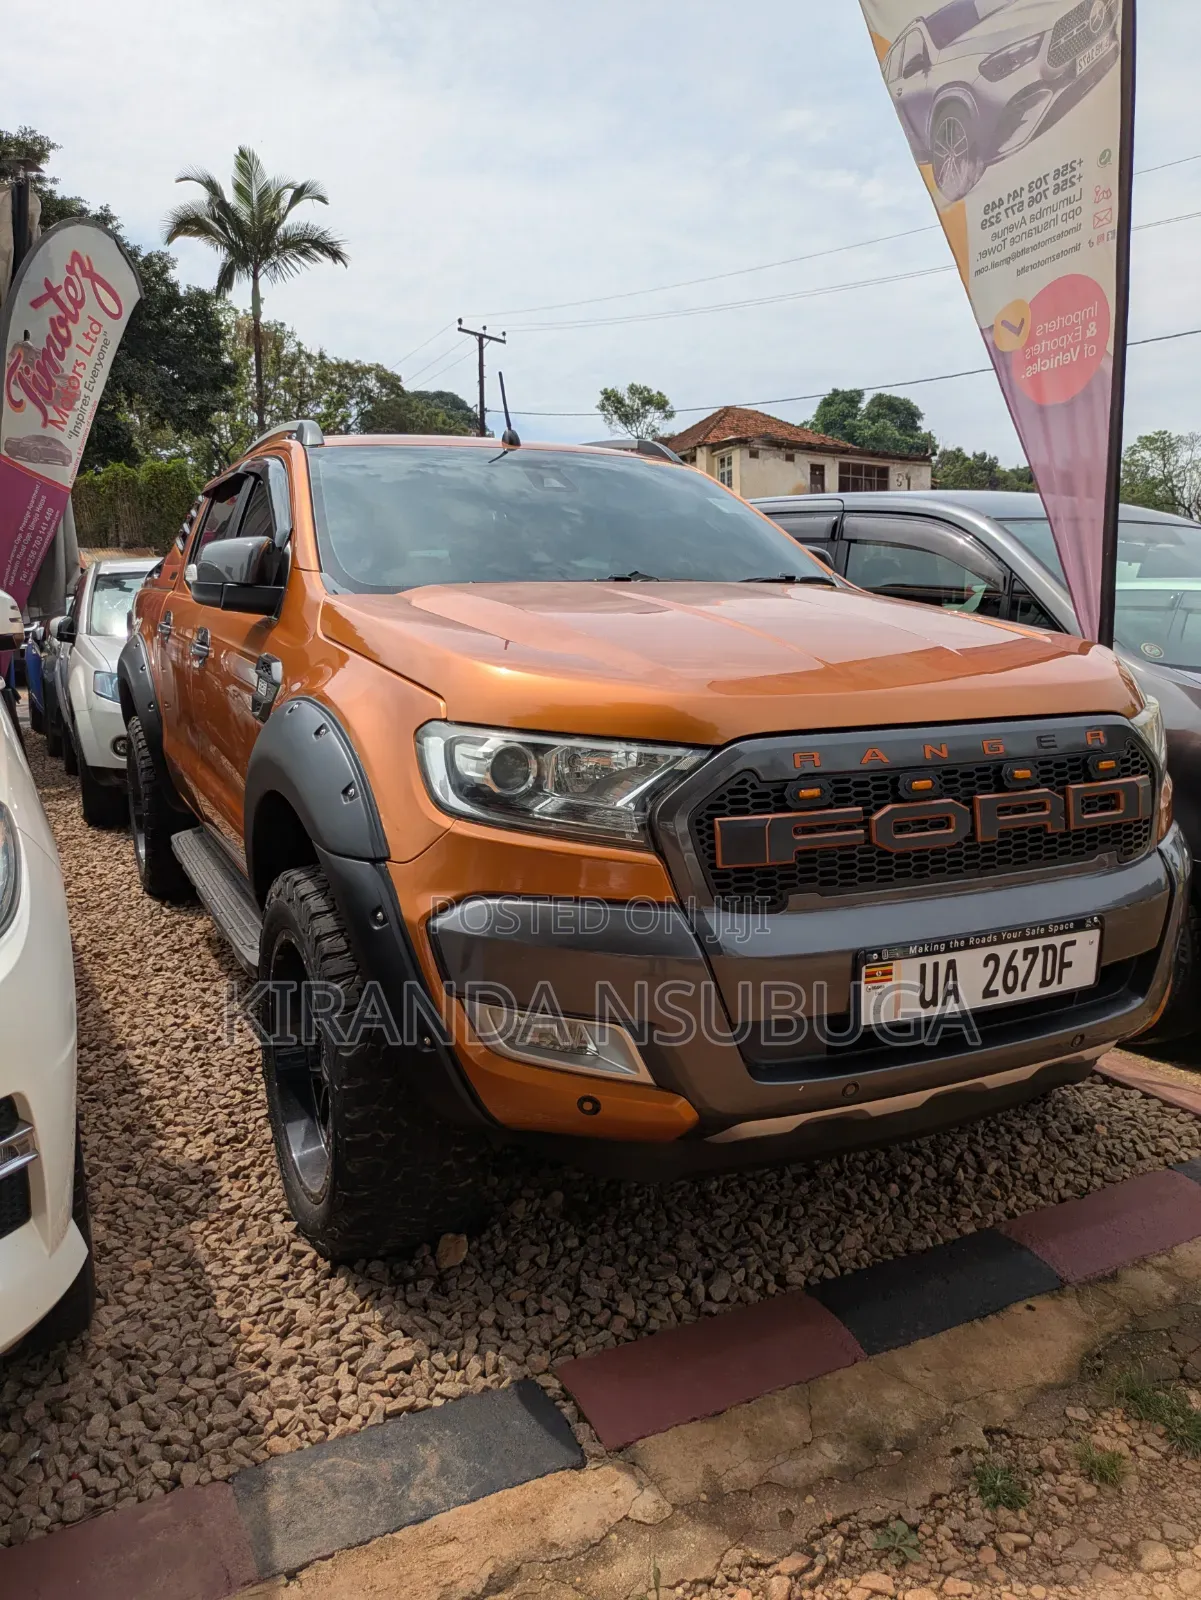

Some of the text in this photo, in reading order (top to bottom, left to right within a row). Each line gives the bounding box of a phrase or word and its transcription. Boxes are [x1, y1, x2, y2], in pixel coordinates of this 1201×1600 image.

[6, 249, 124, 429] Timotez
[48, 315, 104, 432] Motors Ltd
[9, 560, 20, 586] Nakasero
[16, 544, 26, 560] Road
[28, 512, 40, 532] Umoja
[36, 495, 47, 513] House
[19, 510, 31, 532] Prestige
[27, 485, 41, 511] Apartment
[20, 507, 54, 582] Tel: +256 703 141 449
[793, 729, 1108, 769] RANGER
[714, 774, 1151, 869] FORD
[909, 942, 946, 955] Making
[950, 940, 965, 948] the
[968, 934, 998, 946] Roads
[1001, 930, 1022, 940] Your
[1024, 926, 1046, 937] Safe
[1048, 921, 1074, 933] Space
[919, 940, 1077, 1009] UA 267DF
